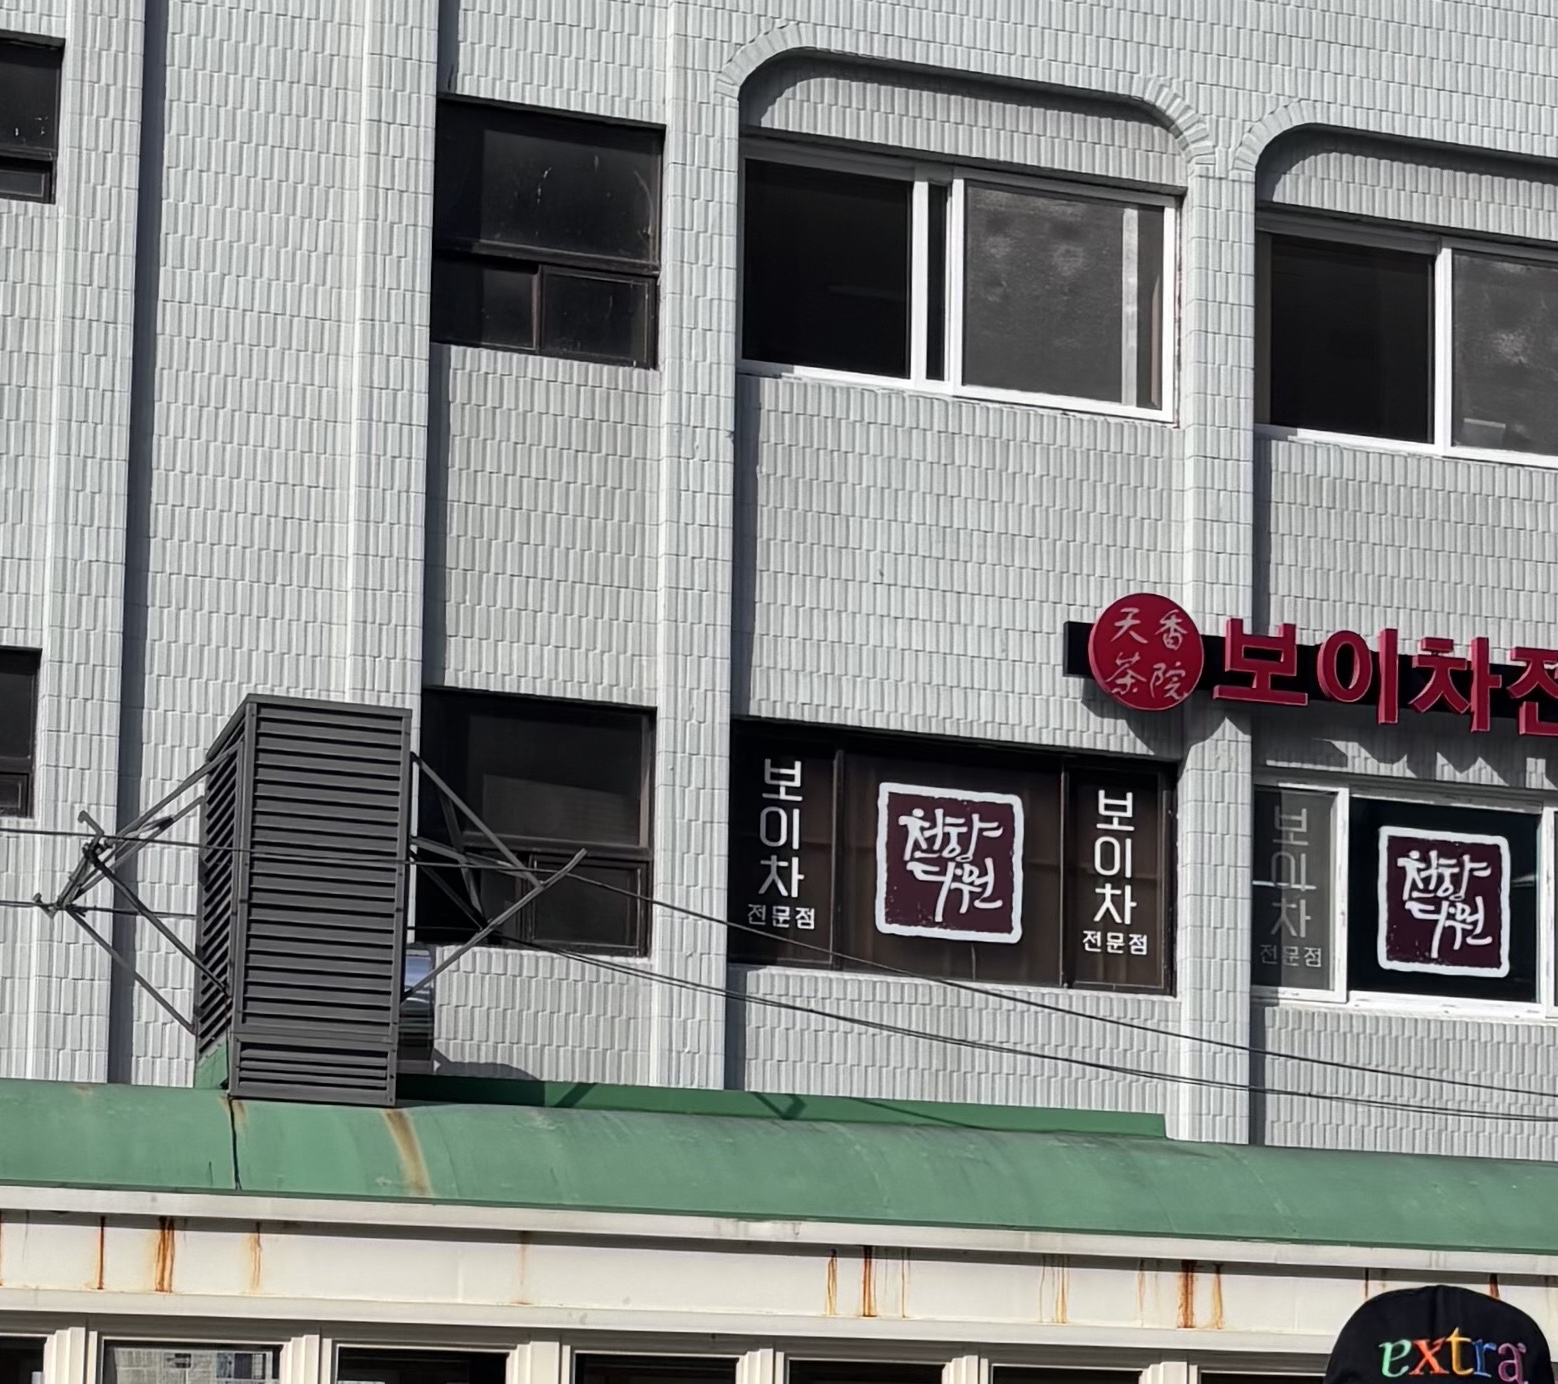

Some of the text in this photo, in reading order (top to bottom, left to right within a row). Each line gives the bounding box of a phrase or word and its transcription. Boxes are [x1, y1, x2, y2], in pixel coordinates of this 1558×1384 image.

[758, 758, 805, 898] 보이차
[1093, 789, 1137, 925] 보이차
[1271, 805, 1311, 938] 보이차
[747, 903, 815, 930] 전문점
[1082, 930, 1148, 956] 전문점
